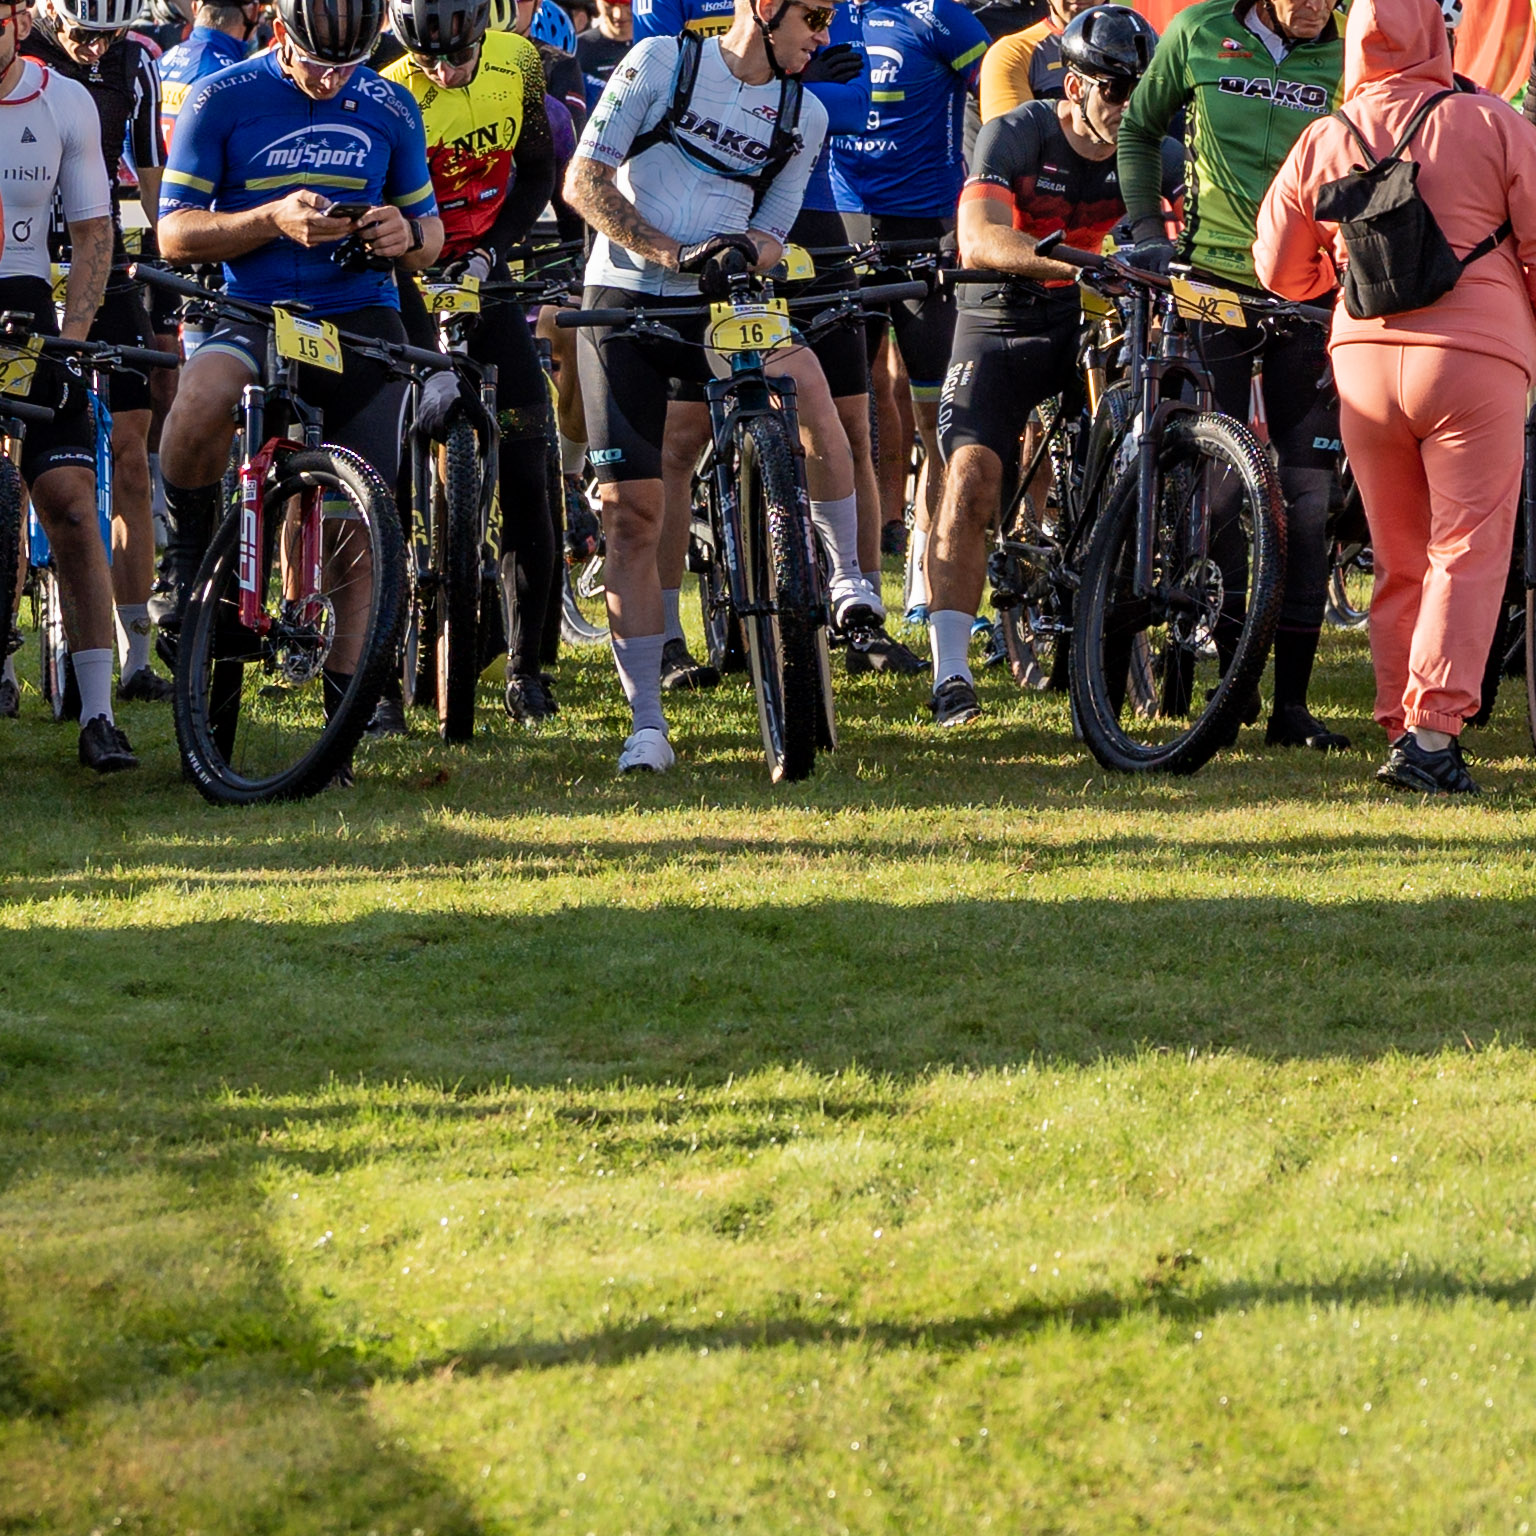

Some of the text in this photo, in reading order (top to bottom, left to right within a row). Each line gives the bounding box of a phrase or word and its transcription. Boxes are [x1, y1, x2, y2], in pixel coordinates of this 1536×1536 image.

[192, 70, 260, 114] ASFALT.LV
[1218, 75, 1329, 108] DAKO
[298, 336, 319, 359] 15
[739, 323, 764, 345] 16
